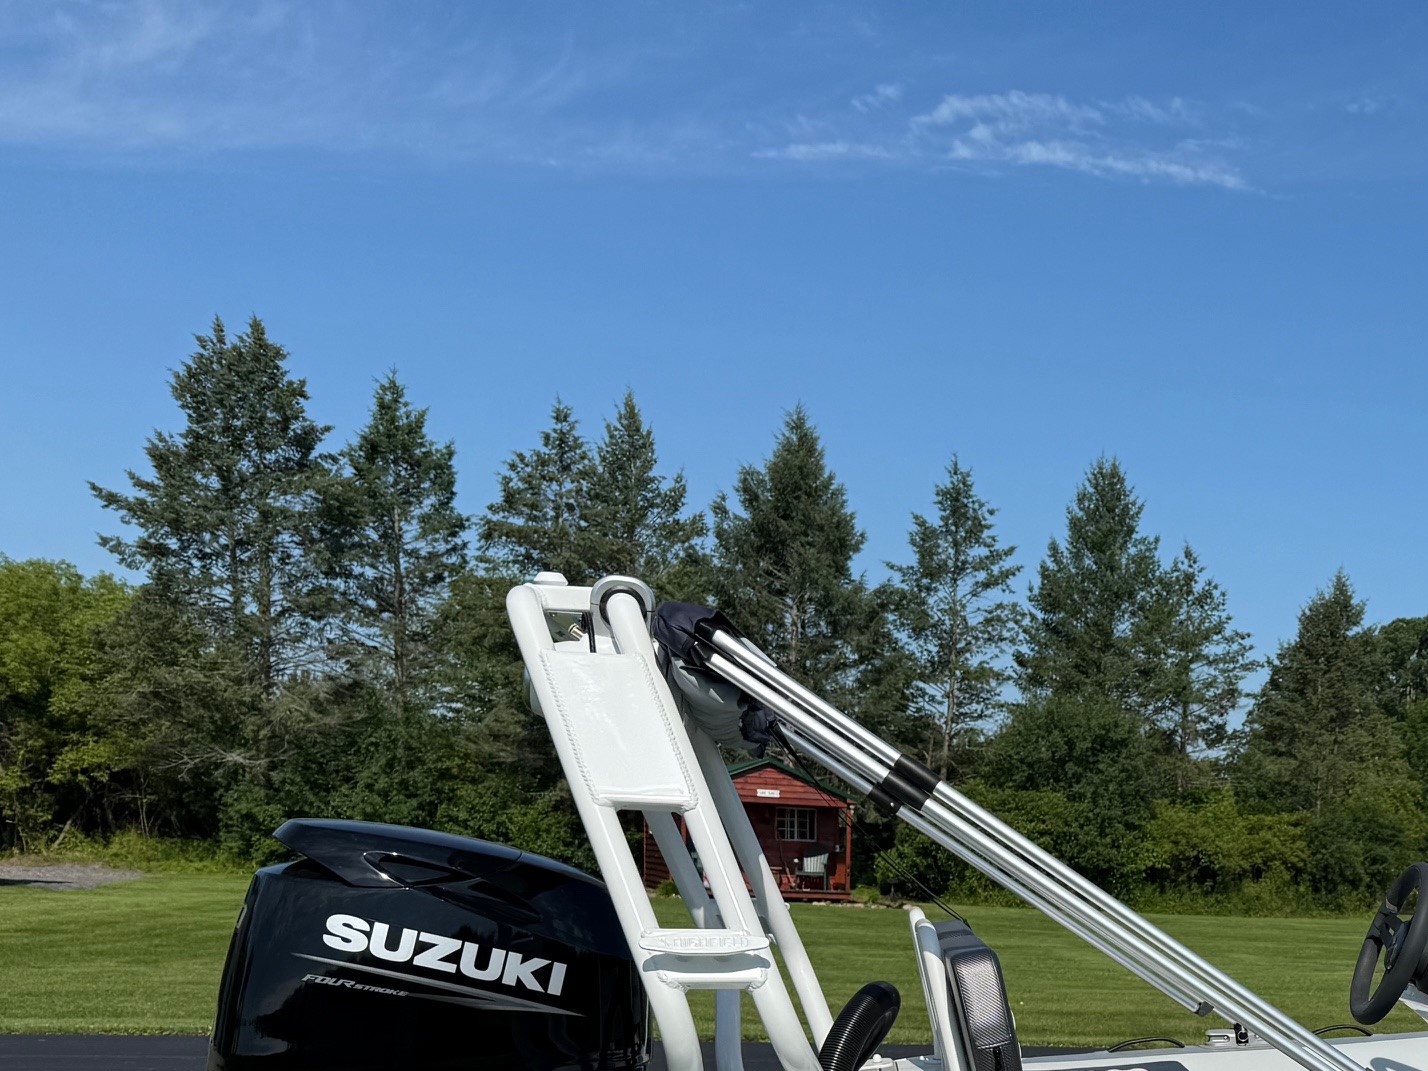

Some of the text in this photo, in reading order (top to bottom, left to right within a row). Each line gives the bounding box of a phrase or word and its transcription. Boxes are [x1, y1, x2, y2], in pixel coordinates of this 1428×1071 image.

[323, 913, 567, 996] SUZUKI
[301, 974, 409, 996] FOUR STROKE
